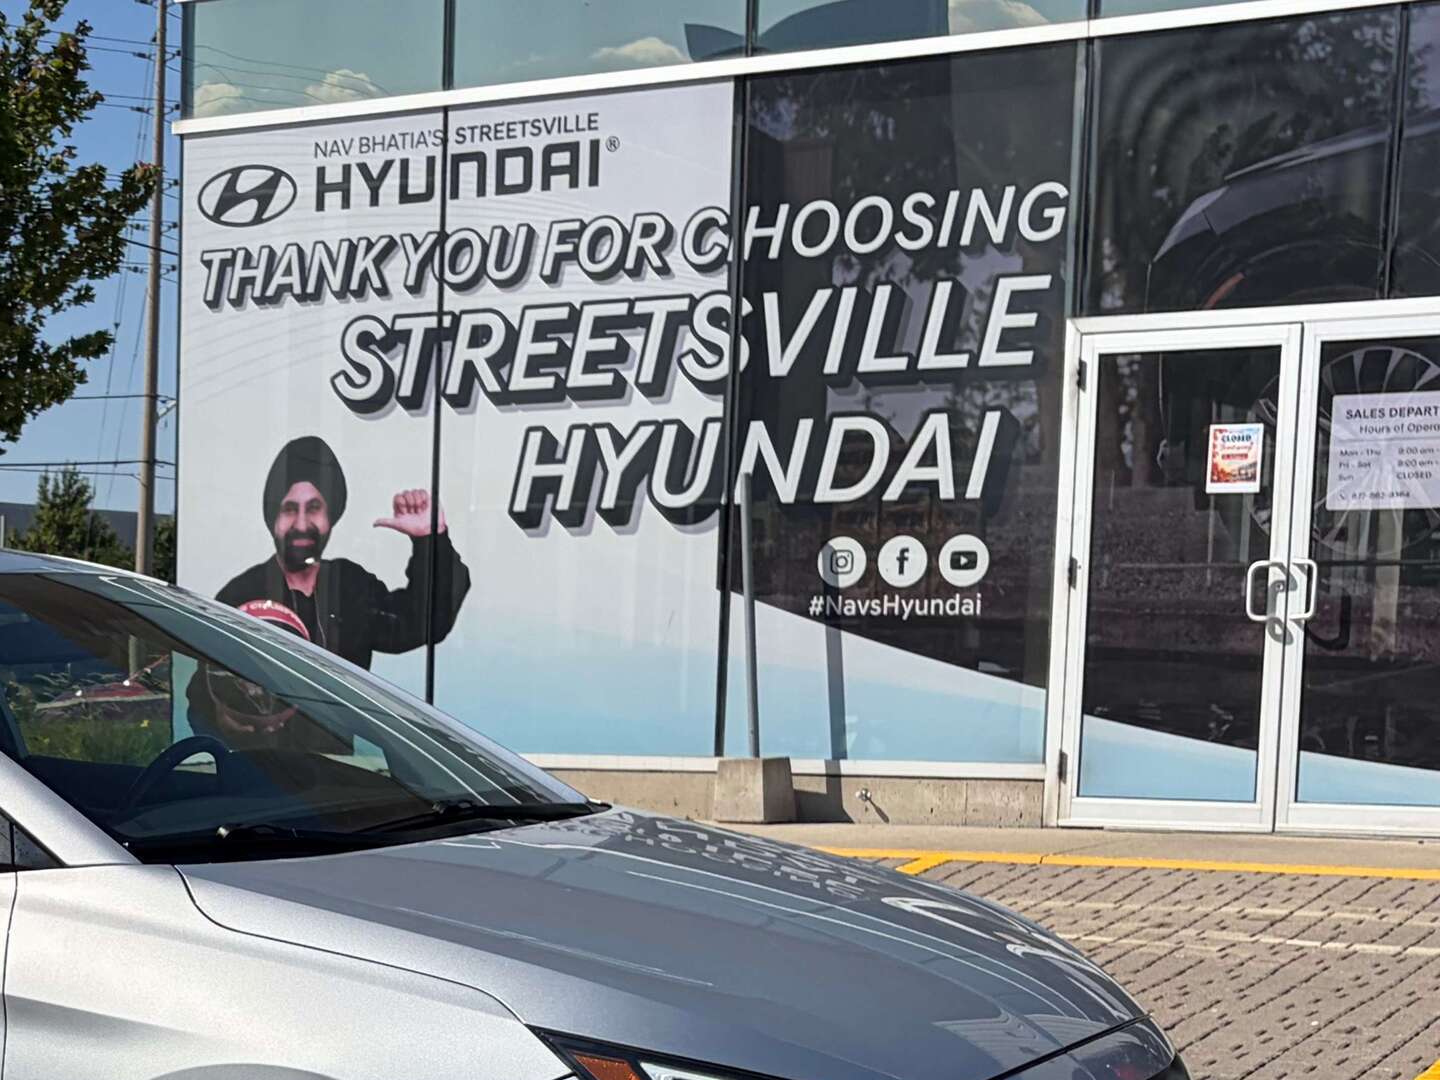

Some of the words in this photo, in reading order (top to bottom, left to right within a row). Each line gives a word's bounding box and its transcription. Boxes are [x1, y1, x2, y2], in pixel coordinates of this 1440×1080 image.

[313, 137, 354, 159] NAV
[358, 128, 446, 154] BHATIA'S
[455, 112, 600, 144] STREETSVILLE
[201, 234, 396, 308] THANK
[400, 223, 535, 290] YOU
[542, 212, 673, 284] FOR
[681, 181, 1070, 269] CHOOSING
[330, 274, 1053, 409] STREETSVILLE
[1345, 407, 1386, 420] SALES
[1360, 425, 1391, 434] Hours
[1394, 423, 1404, 433] of
[509, 409, 1004, 526] HYUNDAI
[1396, 471, 1432, 480] CLOSED
[809, 592, 982, 621] #NavsHyundai
